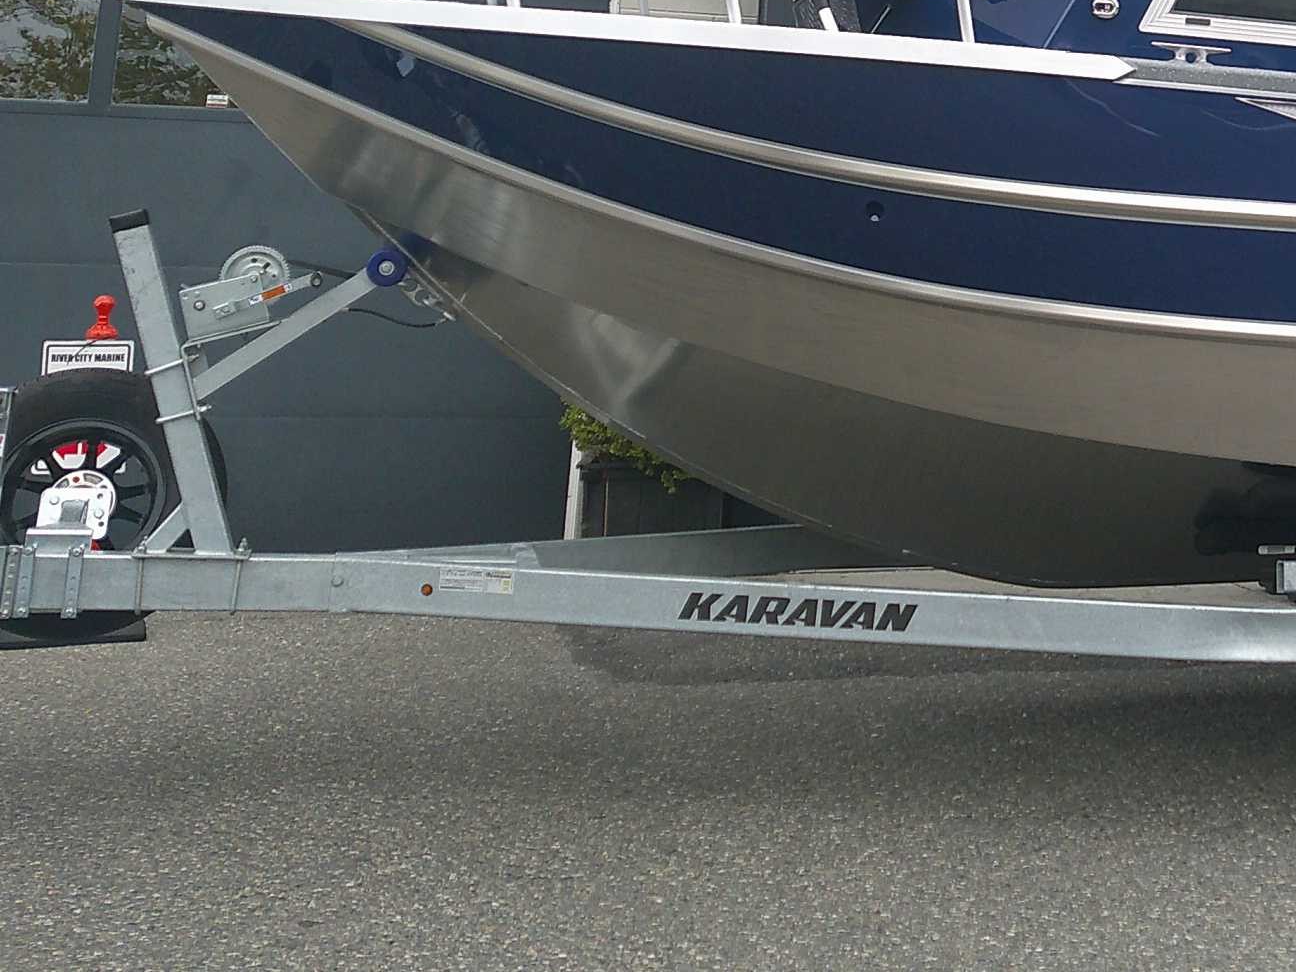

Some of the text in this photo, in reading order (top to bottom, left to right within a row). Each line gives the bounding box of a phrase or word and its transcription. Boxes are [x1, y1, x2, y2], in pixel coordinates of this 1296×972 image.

[50, 353, 126, 363] RIVER CITY MARINE
[678, 592, 919, 632] KARAVAN
